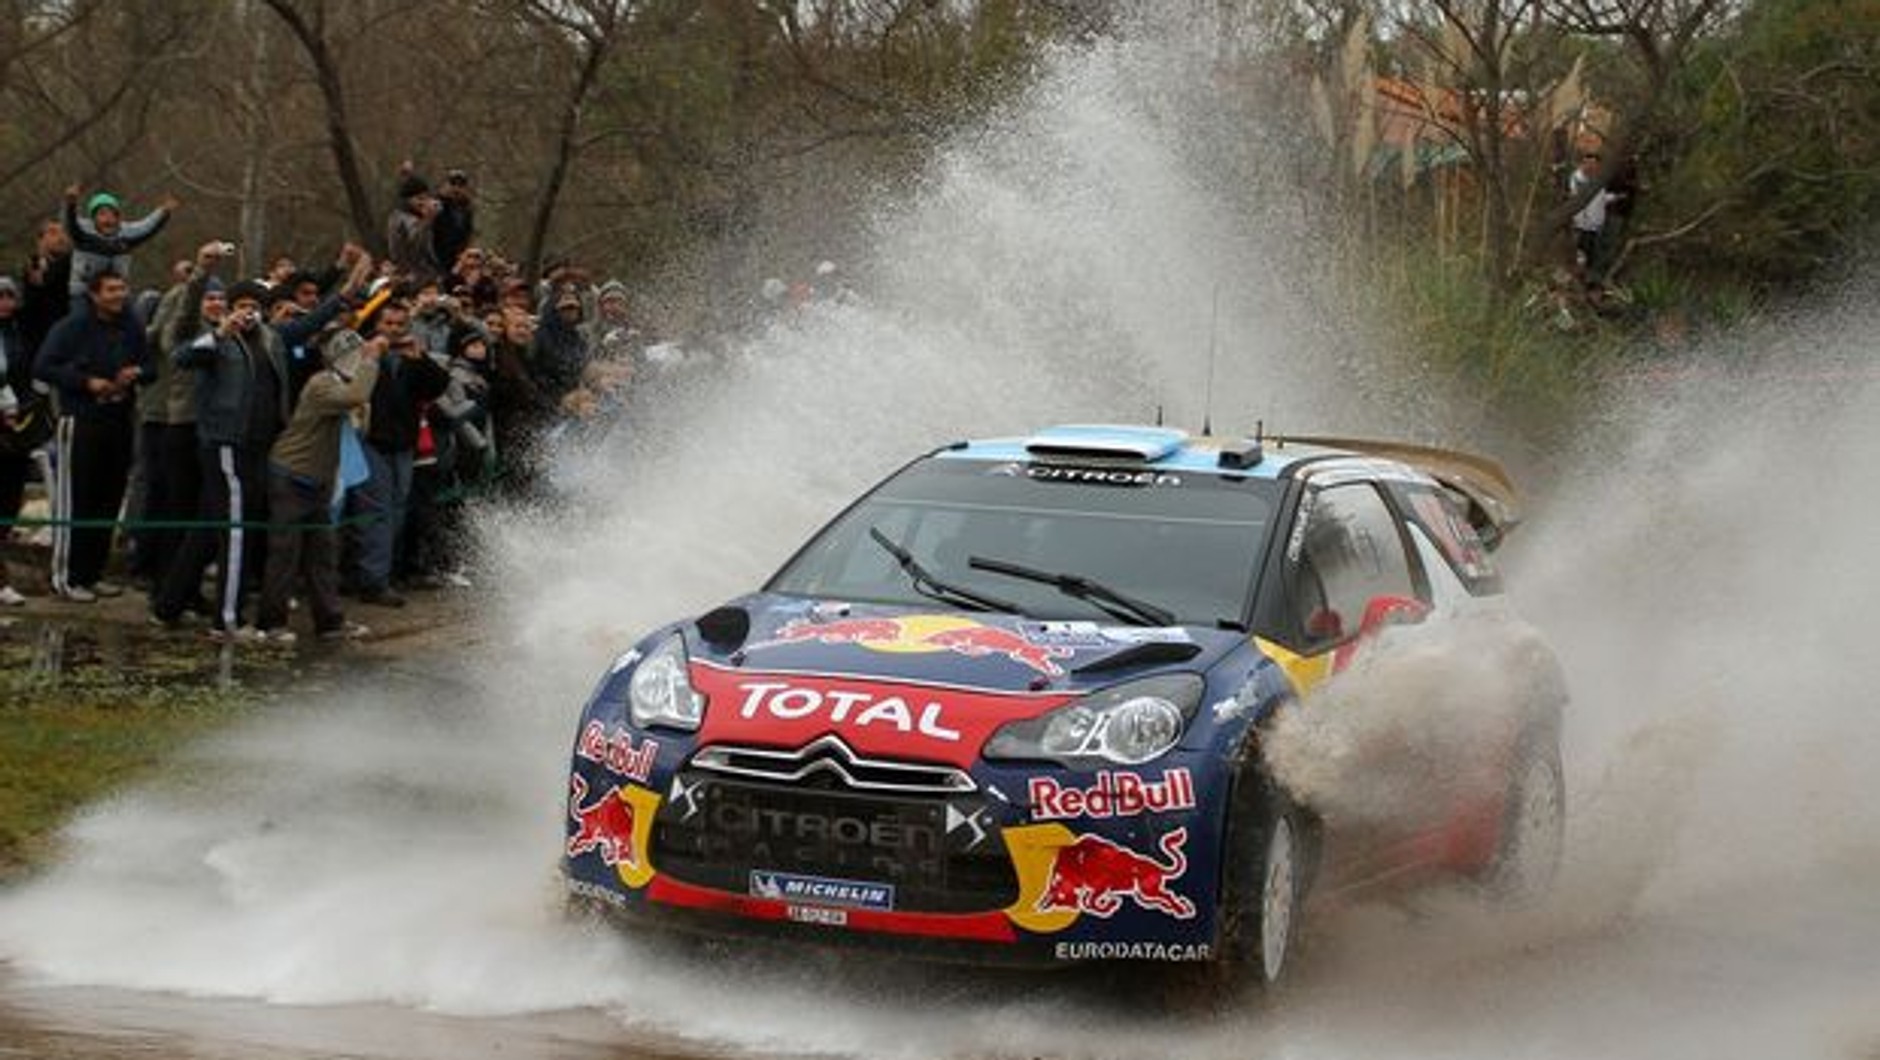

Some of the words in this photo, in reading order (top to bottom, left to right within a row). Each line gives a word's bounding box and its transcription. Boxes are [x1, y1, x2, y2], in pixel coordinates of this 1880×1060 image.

[738, 683, 961, 741] TOTAL
[577, 719, 622, 774] Red
[621, 730, 659, 782] Bull
[1028, 770, 1113, 820] Red
[1113, 767, 1196, 817] Bull
[785, 881, 886, 901] MICHELIN
[1056, 941, 1209, 961] EURODATACAR
